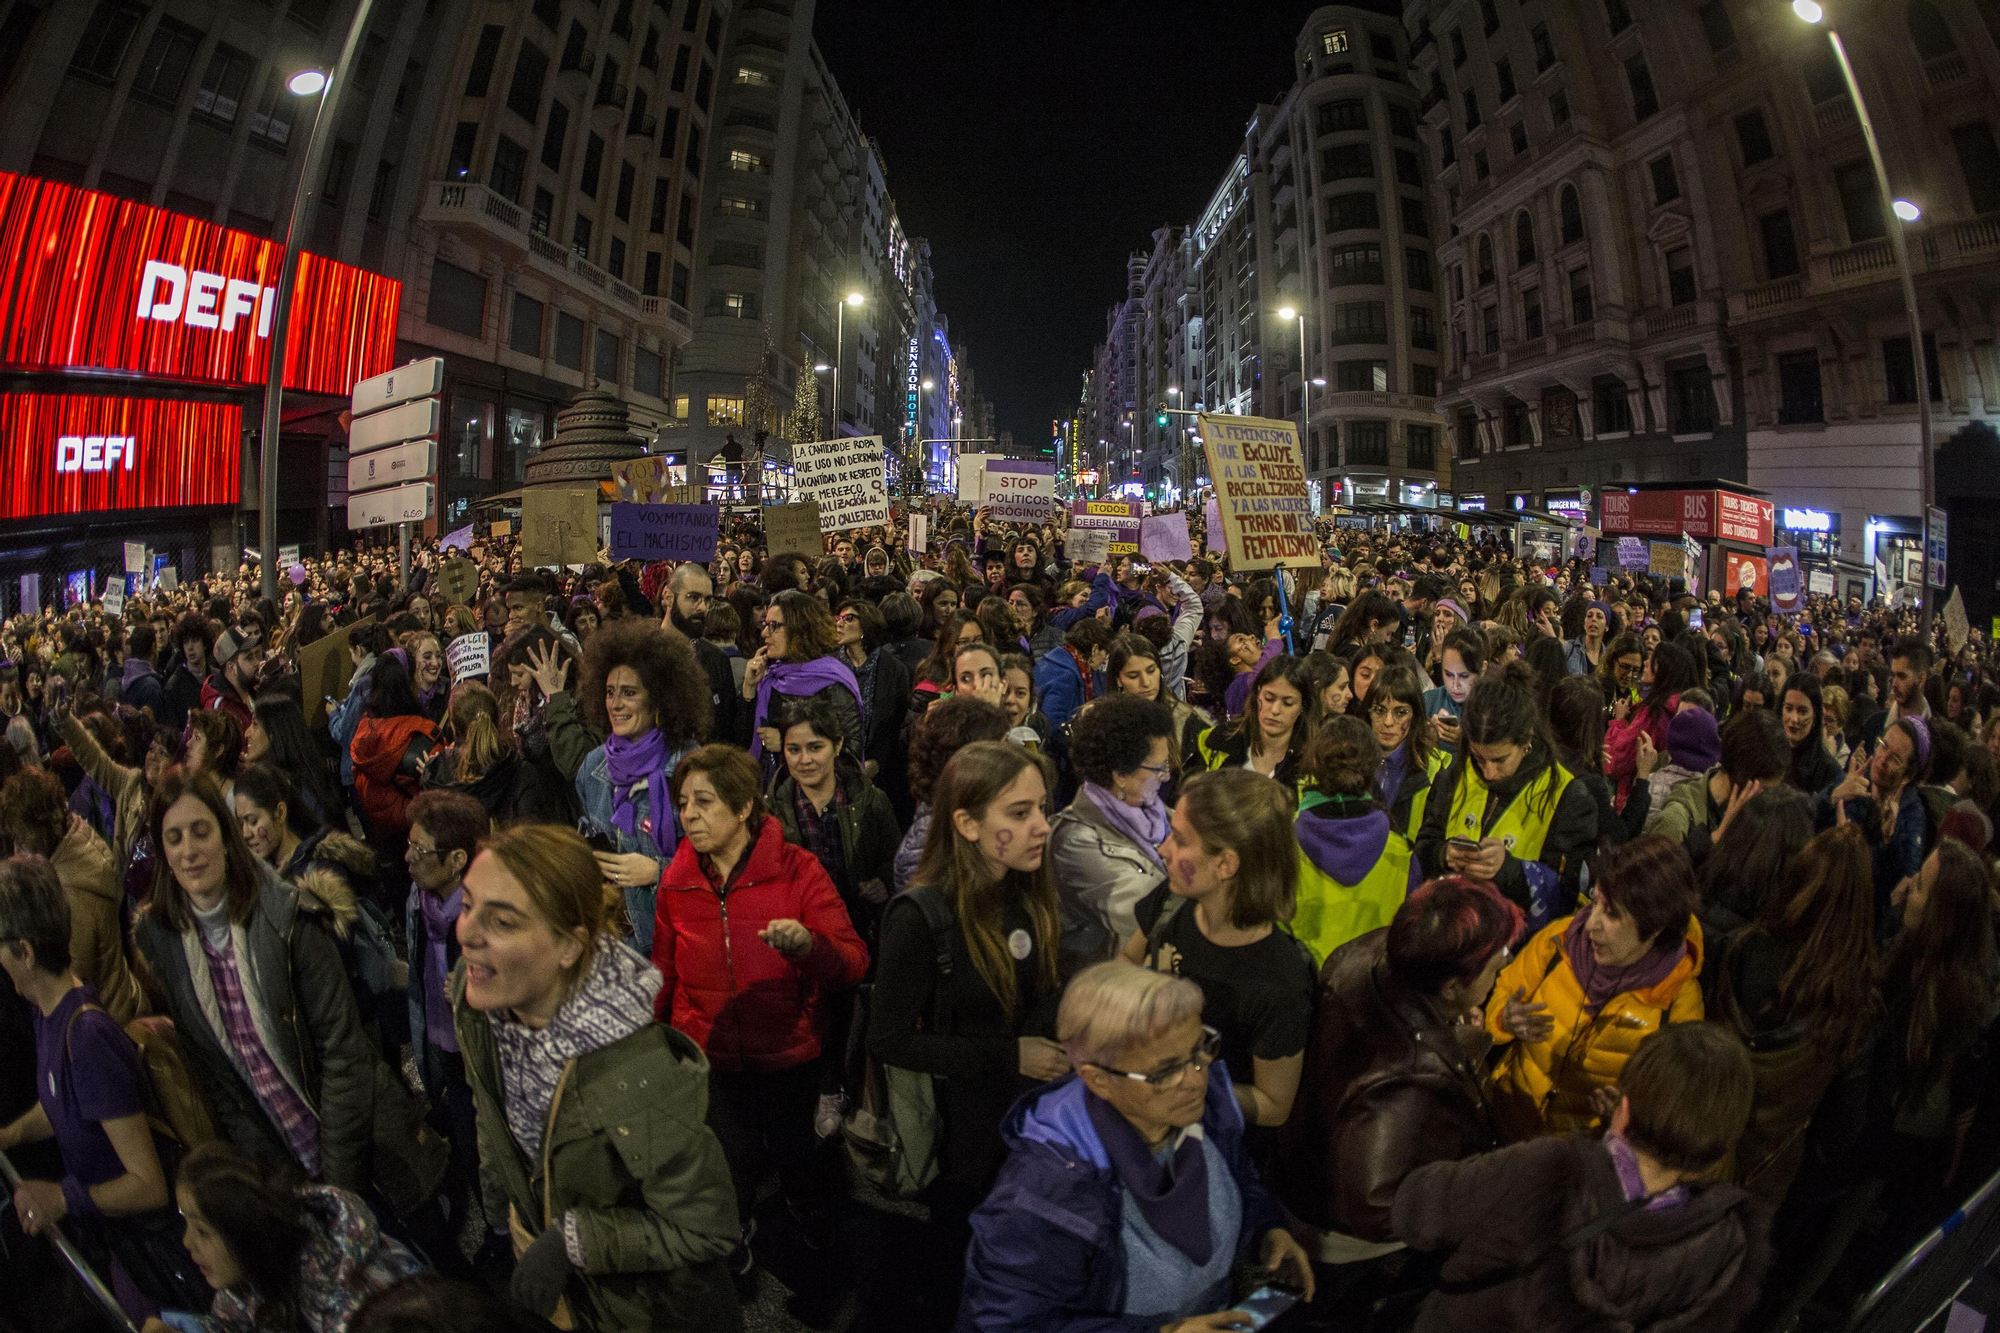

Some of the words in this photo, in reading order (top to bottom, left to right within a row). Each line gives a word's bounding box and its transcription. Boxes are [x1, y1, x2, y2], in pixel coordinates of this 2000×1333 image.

[136, 260, 276, 338] DEFI
[908, 338, 918, 391] SENATOR
[1226, 426, 1292, 444] FEMINISMO
[57, 436, 134, 473] DEFI
[794, 446, 806, 459] LA
[840, 441, 850, 452] DE
[853, 439, 876, 449] ROPA
[1216, 444, 1239, 460] QUE
[625, 462, 658, 480] GOD
[796, 461, 813, 473] QUE
[815, 458, 832, 470] USO
[834, 455, 847, 467] NO
[1225, 465, 1233, 479] A
[1238, 465, 1257, 479] LAS
[1259, 463, 1303, 481] MUJERES
[797, 478, 807, 489] LA
[839, 470, 848, 482] DE
[850, 466, 881, 481] RESPETO
[1000, 476, 1038, 489] STOP
[640, 480, 653, 495] IS
[799, 490, 815, 503] QUE
[1226, 481, 1309, 498] RACIALIZADAS
[869, 494, 881, 505] AL
[989, 492, 1050, 506] POLÍTICOS
[1230, 499, 1238, 513] Y
[1242, 499, 1250, 512] A
[1252, 498, 1269, 512] LAS
[1271, 498, 1312, 512] MUJERES
[1548, 500, 1569, 510] BURGER
[1605, 495, 1630, 513] TOURS
[1684, 494, 1707, 519] BUS
[1722, 495, 1738, 510] TOURS
[1740, 499, 1759, 515] TICKETS
[638, 511, 718, 529] VOXMITANDO
[989, 505, 1051, 518] MISÓGINOS
[820, 514, 836, 529] OSO
[1076, 517, 1139, 529] DEBERÍAMOS
[1235, 514, 1282, 533] TRANS
[1283, 513, 1298, 533] NO
[1299, 513, 1315, 532] ES
[1604, 515, 1630, 529] TICKETS
[1722, 522, 1734, 536] BUS
[1734, 525, 1758, 541] TURÍSTICO
[617, 531, 637, 549] EL
[644, 532, 713, 551] MACHISMO
[1242, 535, 1316, 561] FEMINISMO
